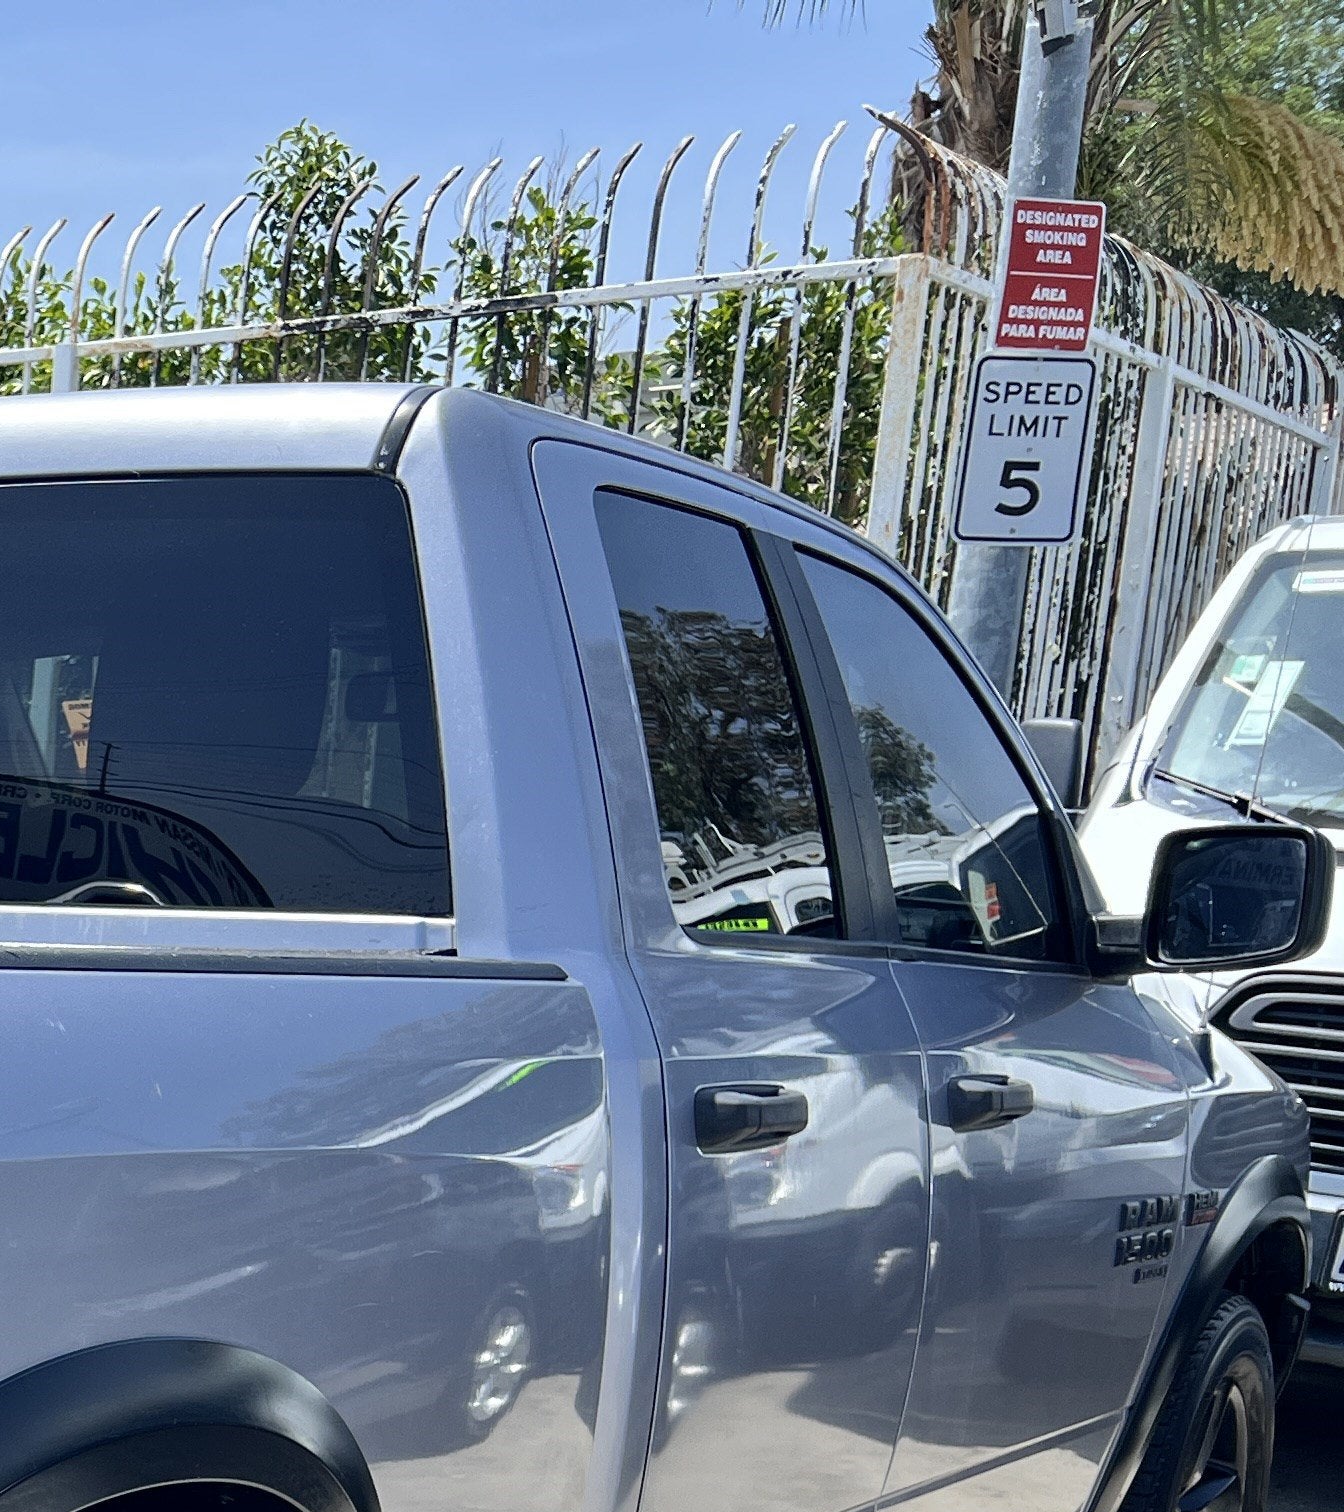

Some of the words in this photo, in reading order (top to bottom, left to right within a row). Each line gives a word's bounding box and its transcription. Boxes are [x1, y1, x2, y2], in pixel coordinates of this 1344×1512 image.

[1017, 209, 1099, 229] DESIGNATED
[1025, 229, 1087, 247] SMOKING
[1035, 249, 1072, 265] AREA
[1031, 283, 1067, 302] ÁREA
[1008, 305, 1084, 322] DESIGNADA
[1001, 323, 1036, 339] PARA
[1038, 325, 1085, 341] FUMAR
[983, 381, 1084, 406] SPEED
[988, 414, 1069, 438] LIMIT
[994, 460, 1041, 517] 5
